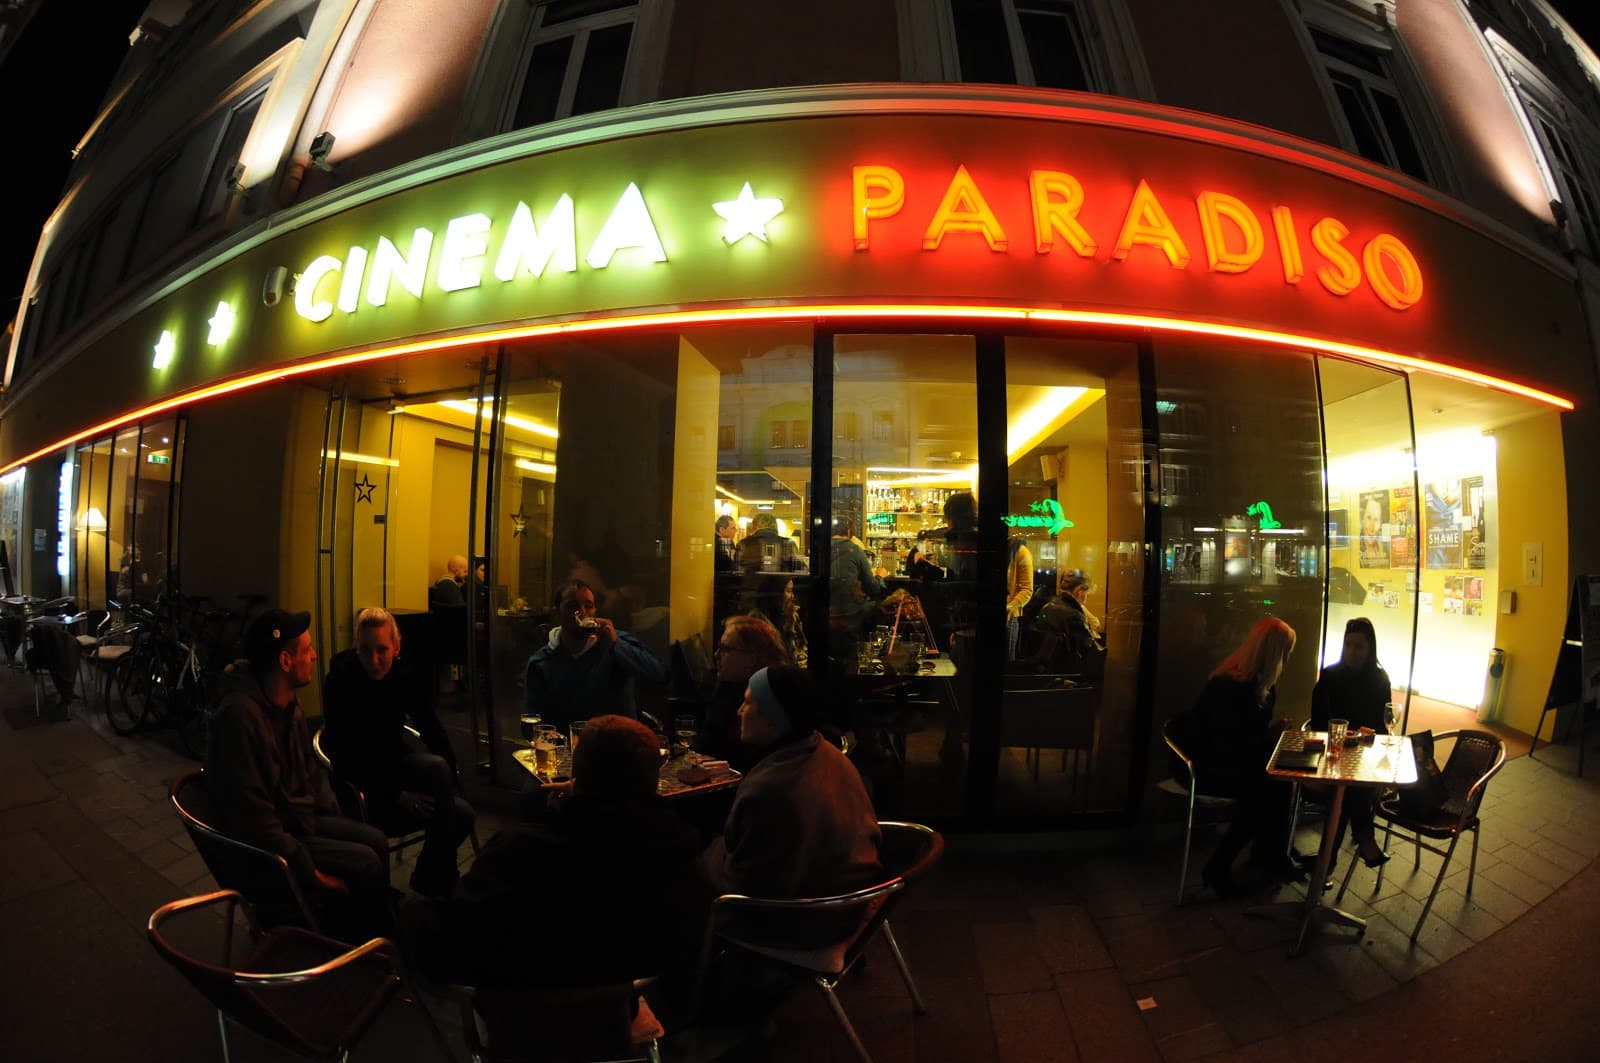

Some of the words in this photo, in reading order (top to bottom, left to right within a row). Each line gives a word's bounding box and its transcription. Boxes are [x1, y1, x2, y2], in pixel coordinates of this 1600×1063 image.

[294, 181, 668, 322] CINEMA
[851, 163, 1424, 311] PARADISO
[1428, 532, 1459, 545] SHAME
